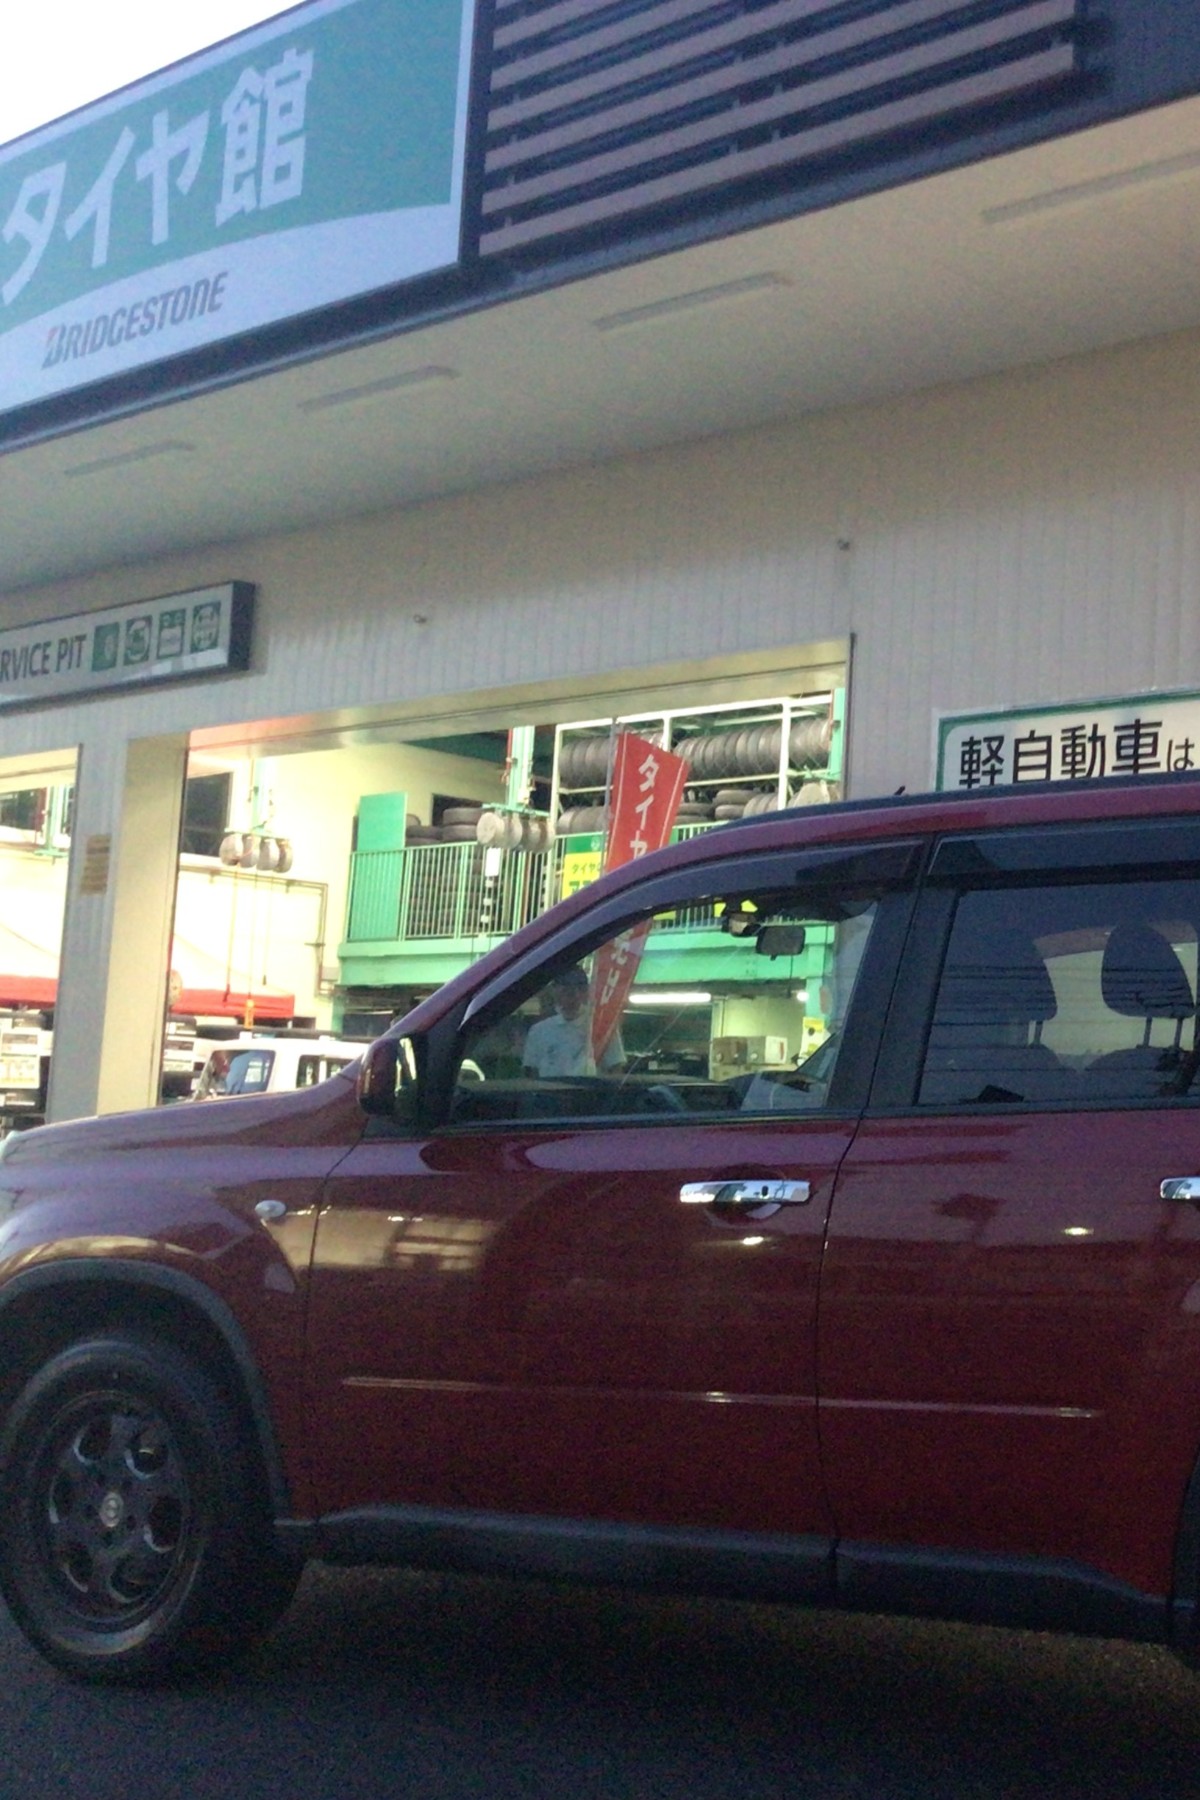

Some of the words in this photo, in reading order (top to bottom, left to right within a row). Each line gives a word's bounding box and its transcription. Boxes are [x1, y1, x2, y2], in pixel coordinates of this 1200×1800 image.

[2, 48, 315, 298] タイヤ館
[41, 272, 228, 370] BRIDGESTONE
[55, 633, 87, 673] PIT
[959, 718, 1195, 789] 軽自動車は
